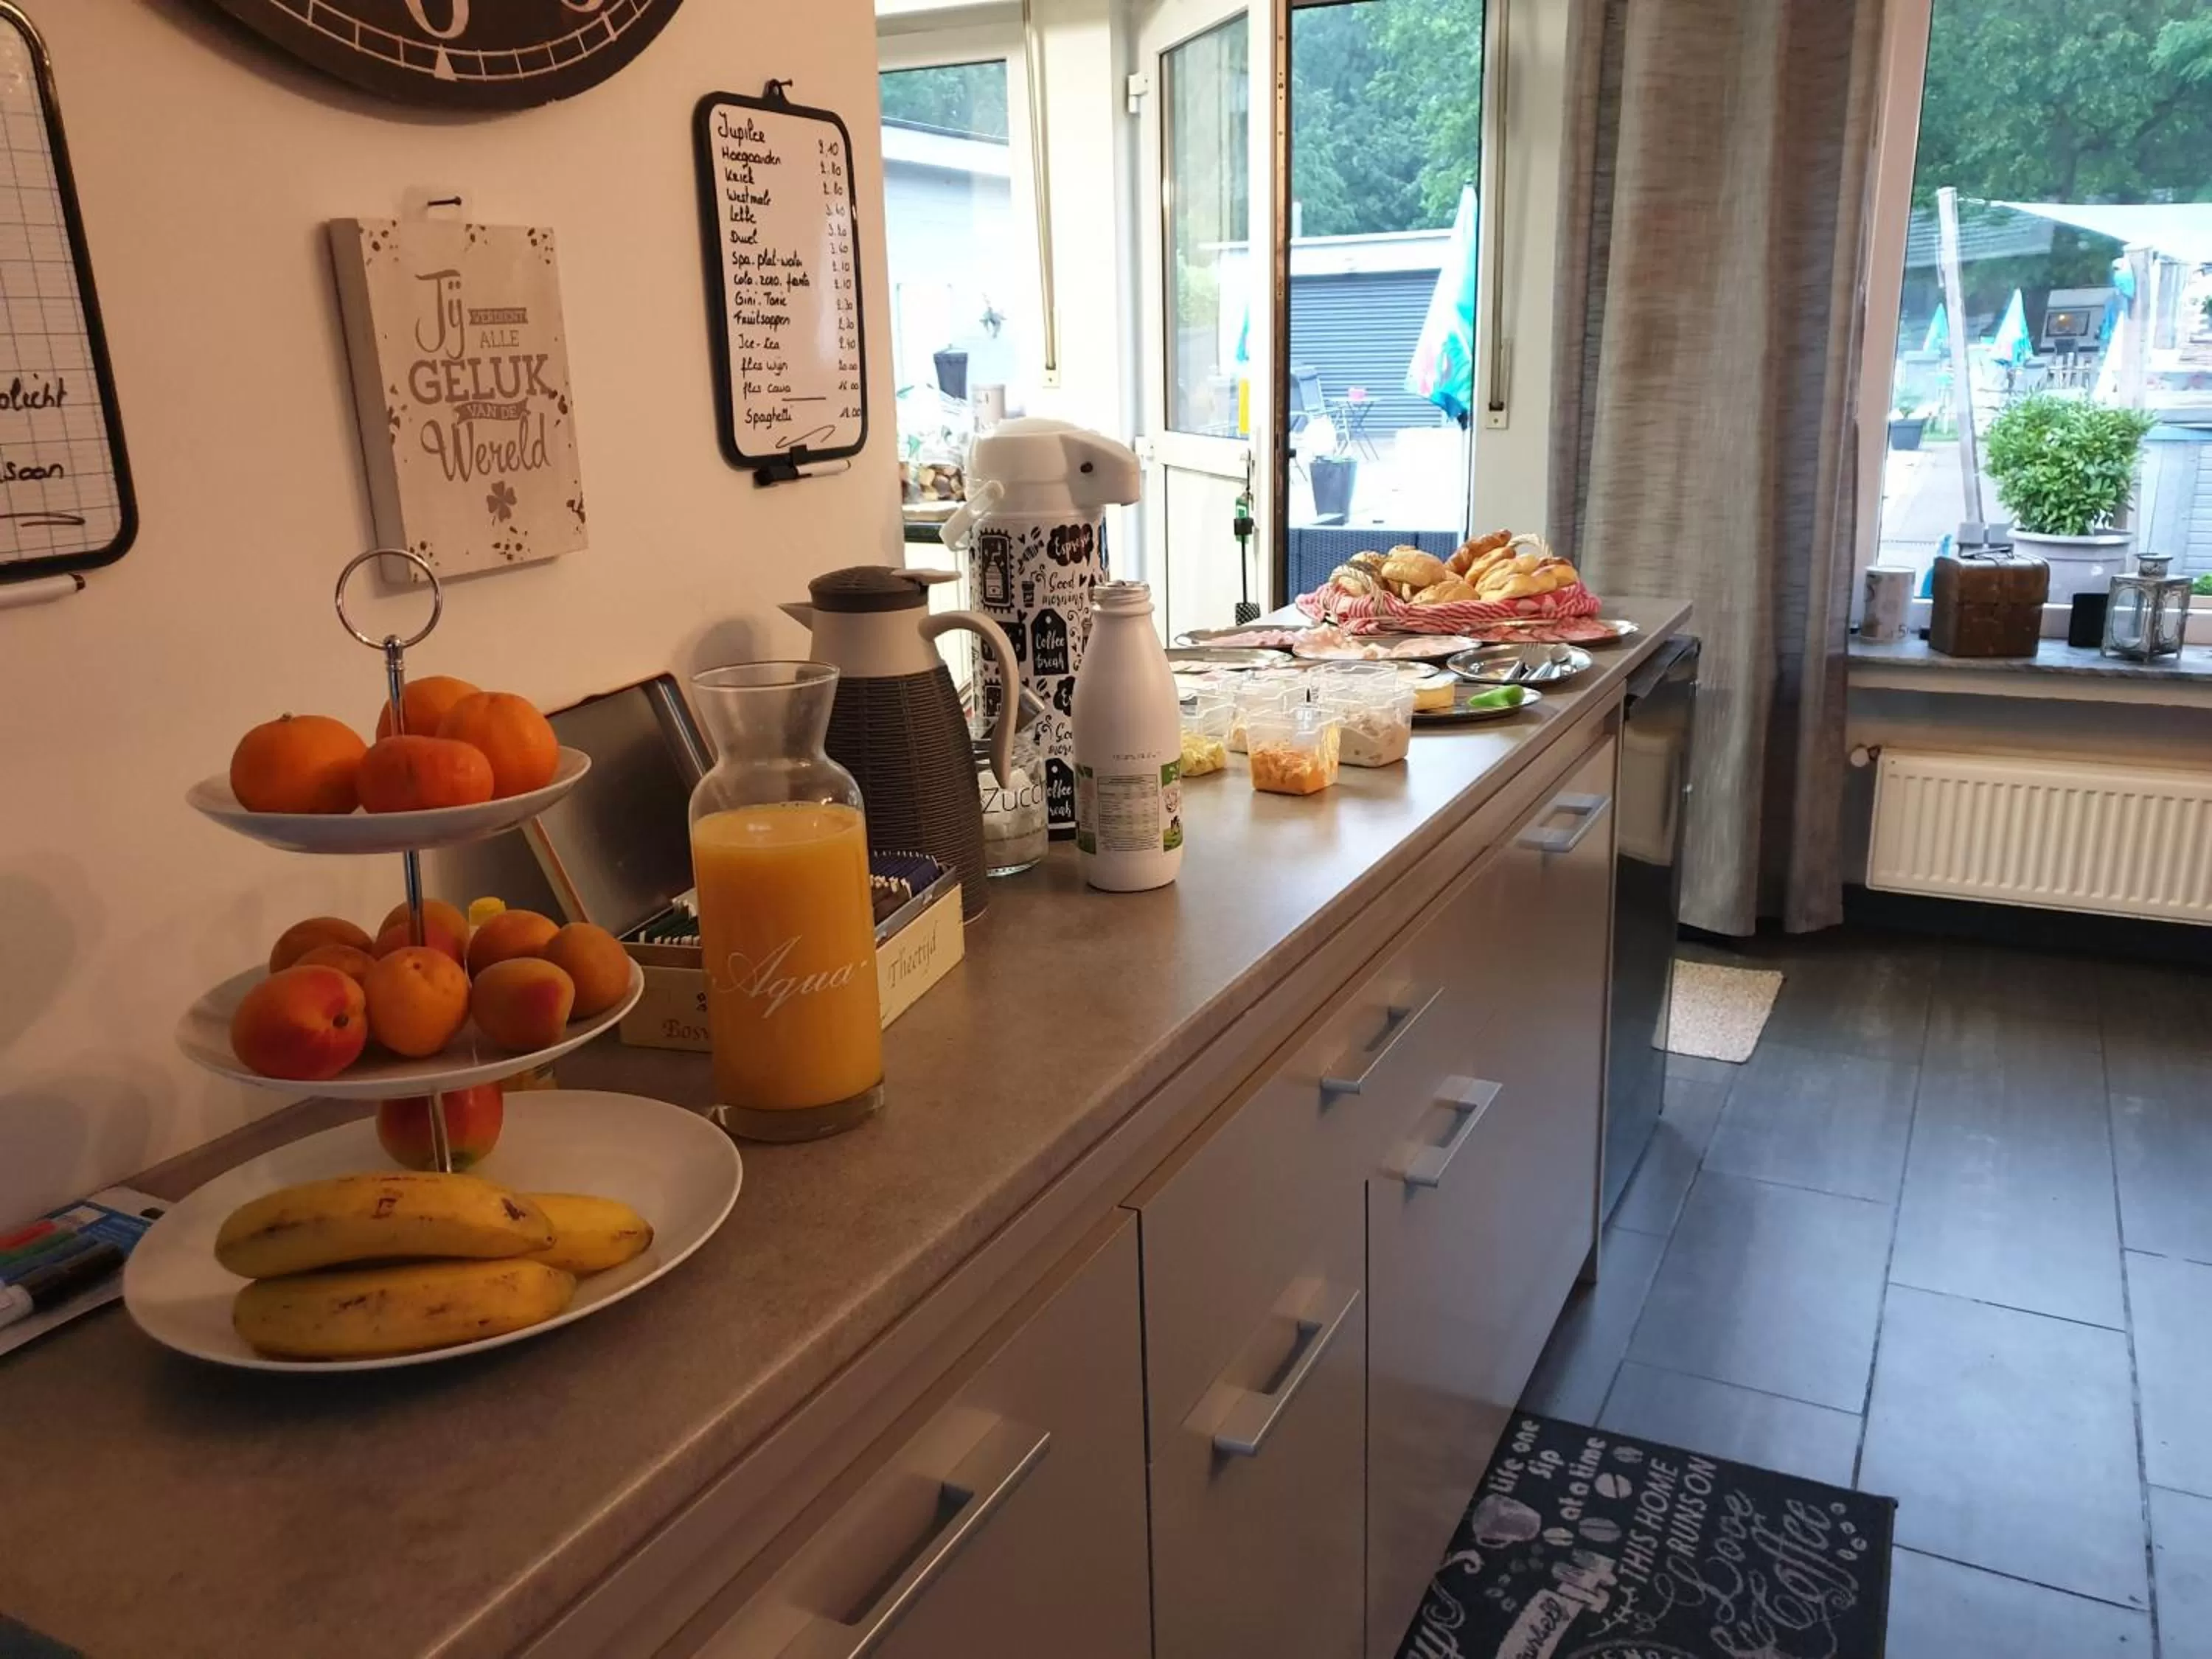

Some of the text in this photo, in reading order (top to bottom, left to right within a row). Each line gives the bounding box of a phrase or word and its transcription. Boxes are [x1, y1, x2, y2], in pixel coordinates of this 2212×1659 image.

[480, 330, 520, 348] ALLE
[408, 353, 557, 405] GELUK
[467, 406, 518, 418] VAN DE
[420, 413, 552, 483] Wereld
[1048, 571, 1075, 591] Good
[1041, 592, 1084, 611] morning
[1035, 629, 1065, 650] Coffee
[1035, 654, 1065, 670] break
[1047, 779, 1073, 798] offee
[712, 934, 855, 1018] Aqua
[1512, 1420, 1540, 1453] one
[1568, 1437, 1607, 1479] time
[1568, 1481, 1590, 1496] a
[1618, 1458, 1679, 1584] THIS HOME
[1666, 1455, 1717, 1558] RUNS ON
[1656, 1489, 1754, 1623] Love
[1748, 1499, 1859, 1630] Coffee
